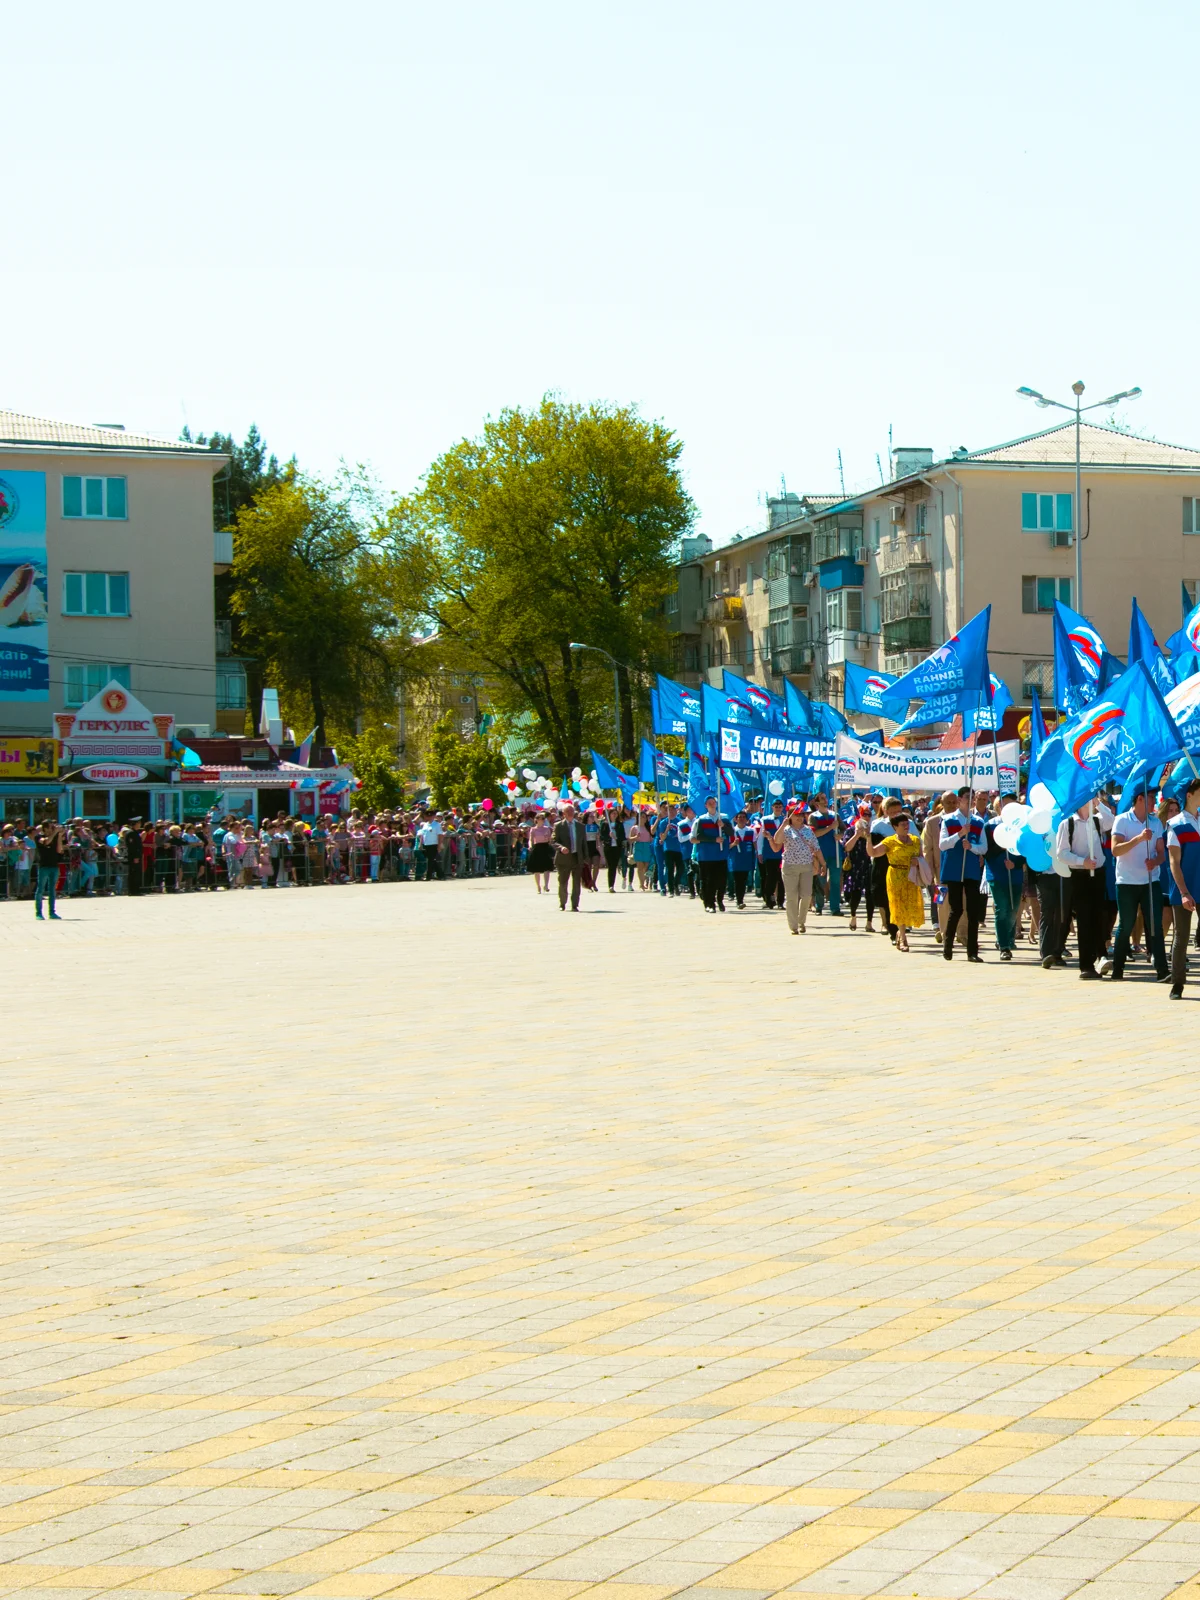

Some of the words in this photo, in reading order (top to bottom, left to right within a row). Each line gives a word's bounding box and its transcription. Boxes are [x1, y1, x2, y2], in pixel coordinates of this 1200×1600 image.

[79, 720, 150, 733] ГЕРКУЛЕС
[754, 735, 801, 754] ЕДИНАЯ
[805, 741, 836, 757] РОСС
[750, 750, 802, 769] СИЛЬНАЯ
[806, 758, 836, 772] РОСС
[858, 758, 958, 777] Краснодарского
[91, 769, 139, 778] ПРОДУКТЫ
